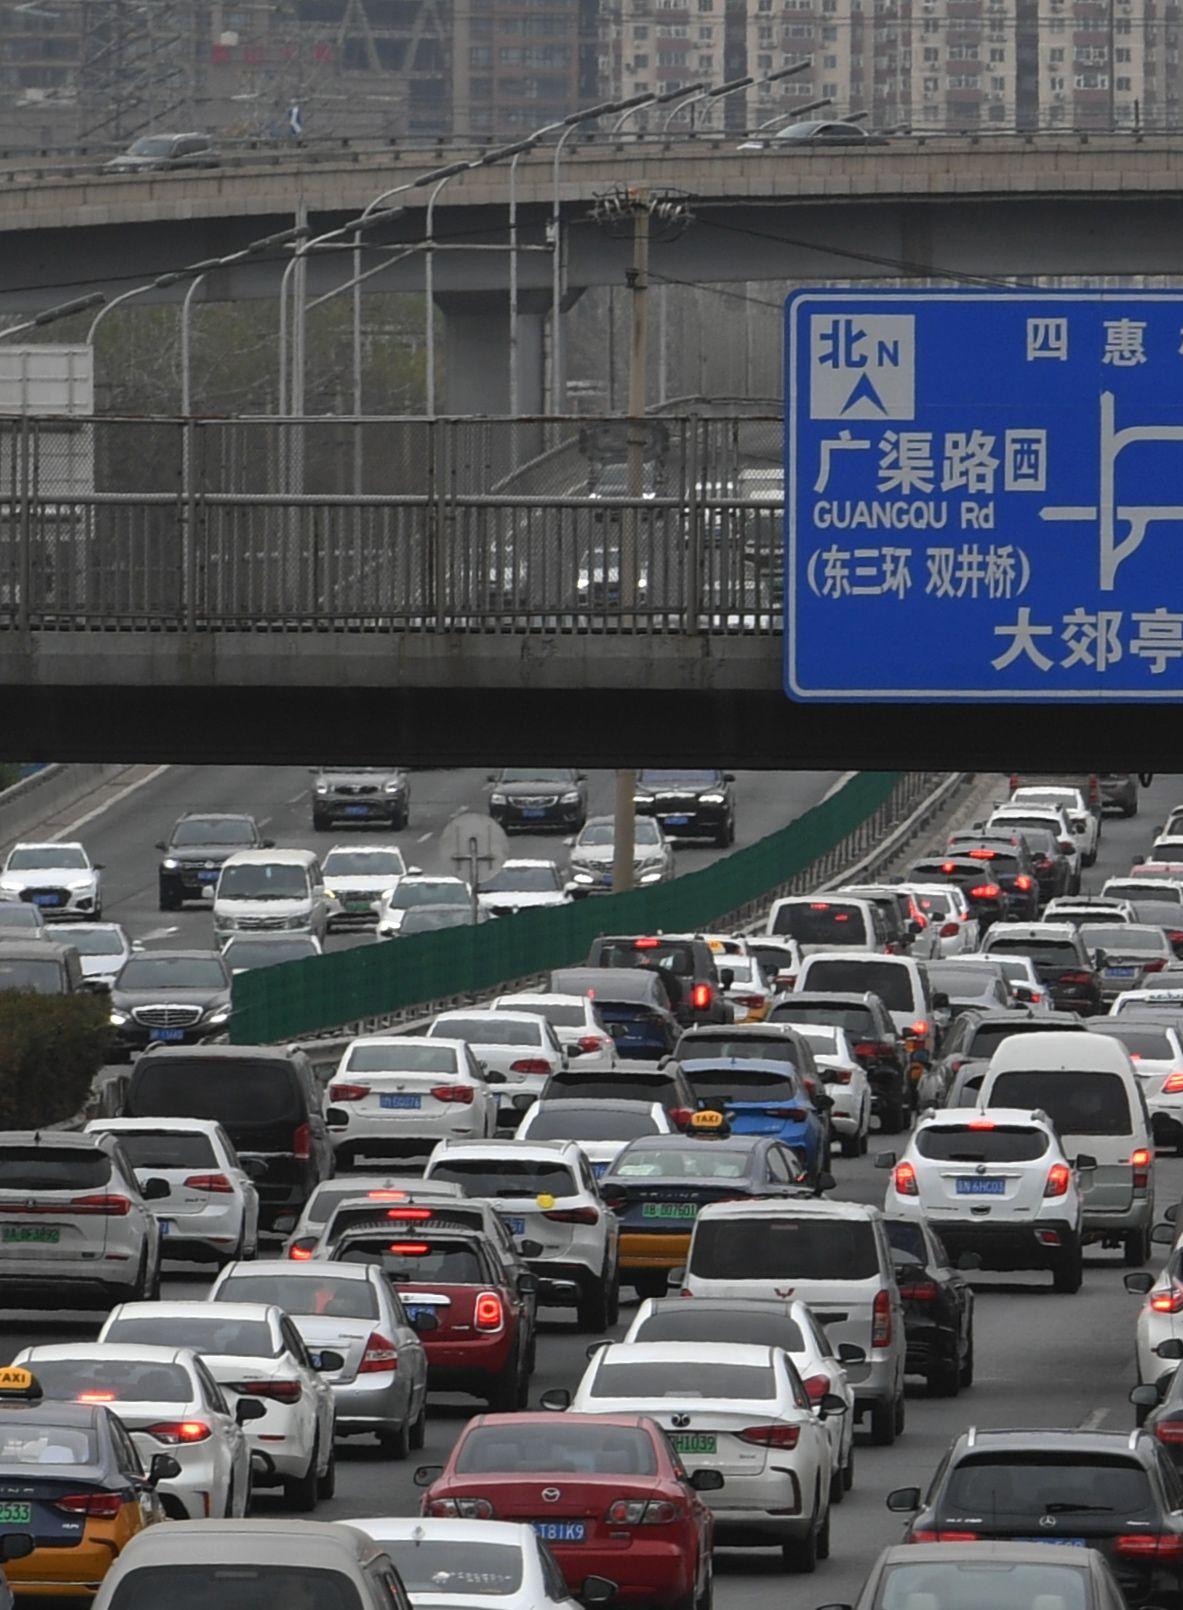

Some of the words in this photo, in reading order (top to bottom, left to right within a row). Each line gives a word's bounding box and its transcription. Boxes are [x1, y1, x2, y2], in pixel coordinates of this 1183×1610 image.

[819, 319, 868, 369] 北
[878, 341, 899, 367] N
[813, 429, 1000, 495] 广渠路
[813, 501, 947, 530] GUANGQU
[961, 502, 994, 529] Rd
[695, 1114, 719, 1124] TAXI
